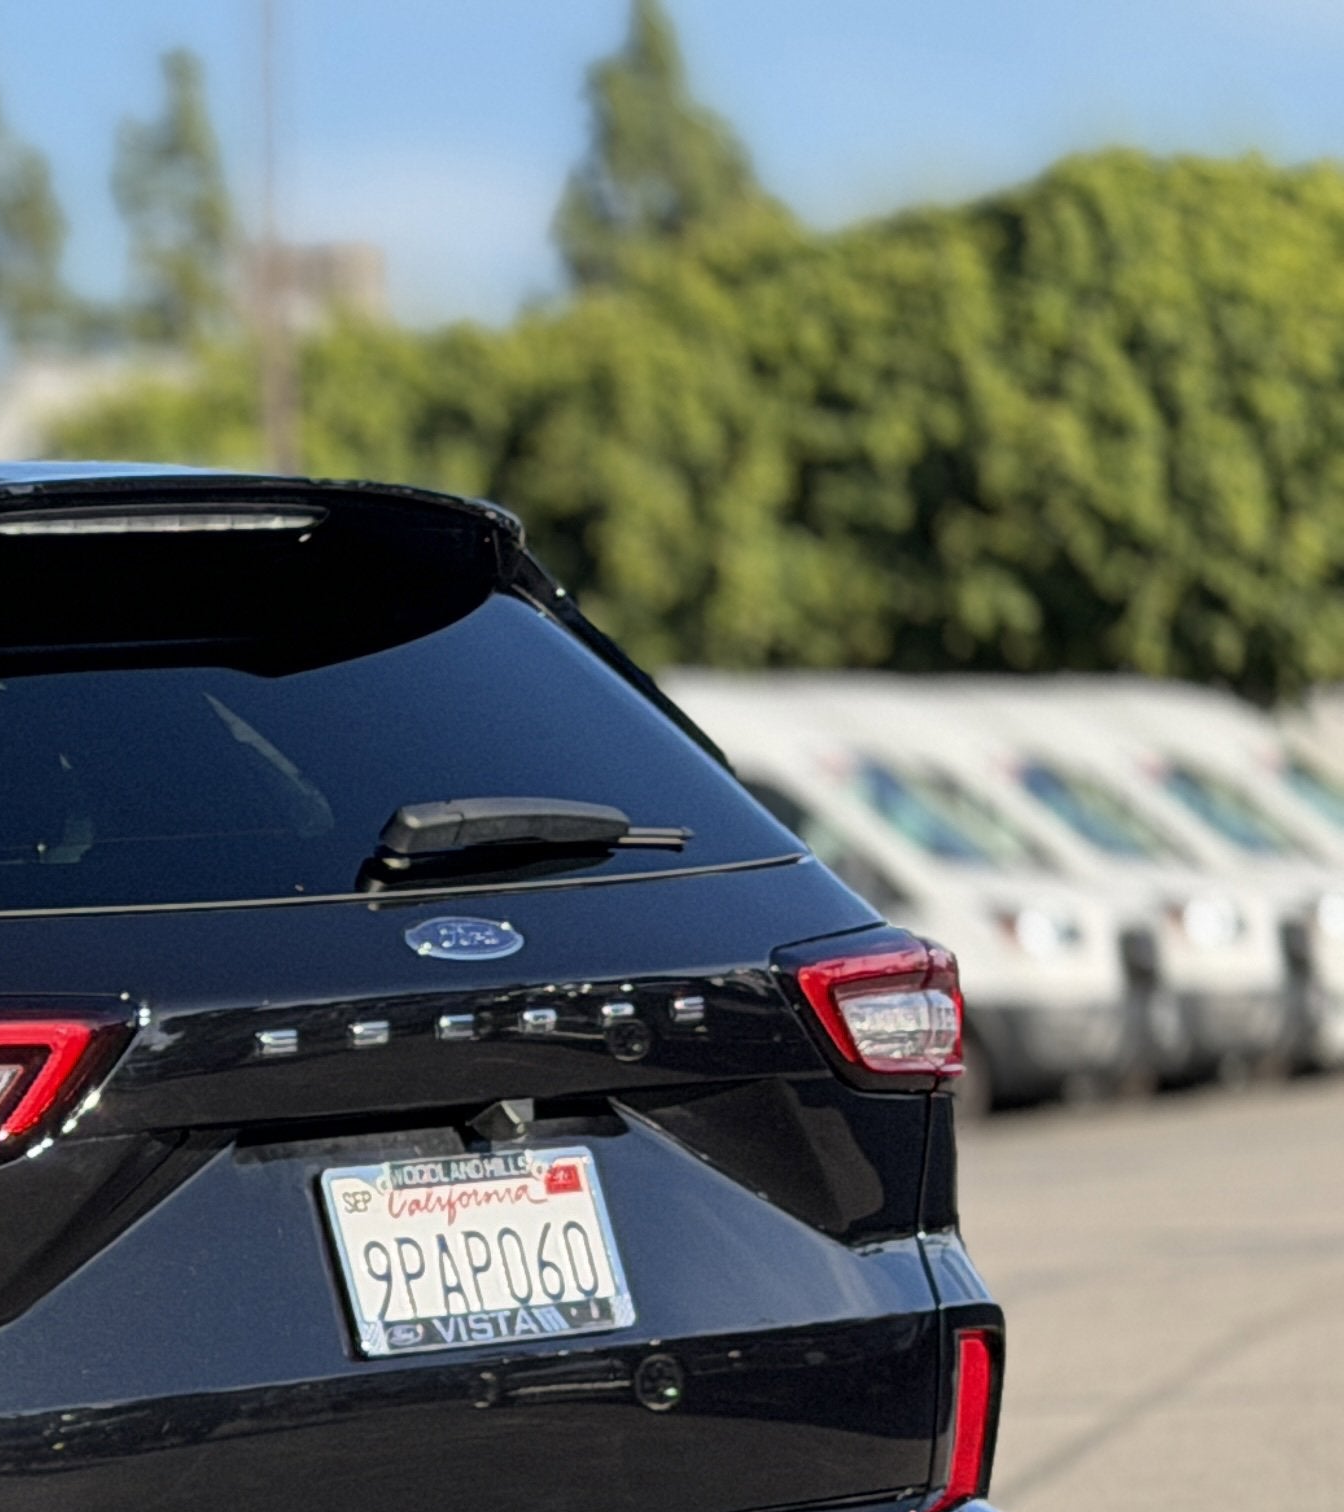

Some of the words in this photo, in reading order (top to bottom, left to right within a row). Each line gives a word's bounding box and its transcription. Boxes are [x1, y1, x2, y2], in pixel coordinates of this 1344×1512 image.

[483, 1154, 528, 1177] HILLS
[342, 1190, 372, 1214] SEP
[386, 1184, 550, 1226] California
[362, 1220, 600, 1320] 9PAP060
[431, 1306, 540, 1344] VISTA
